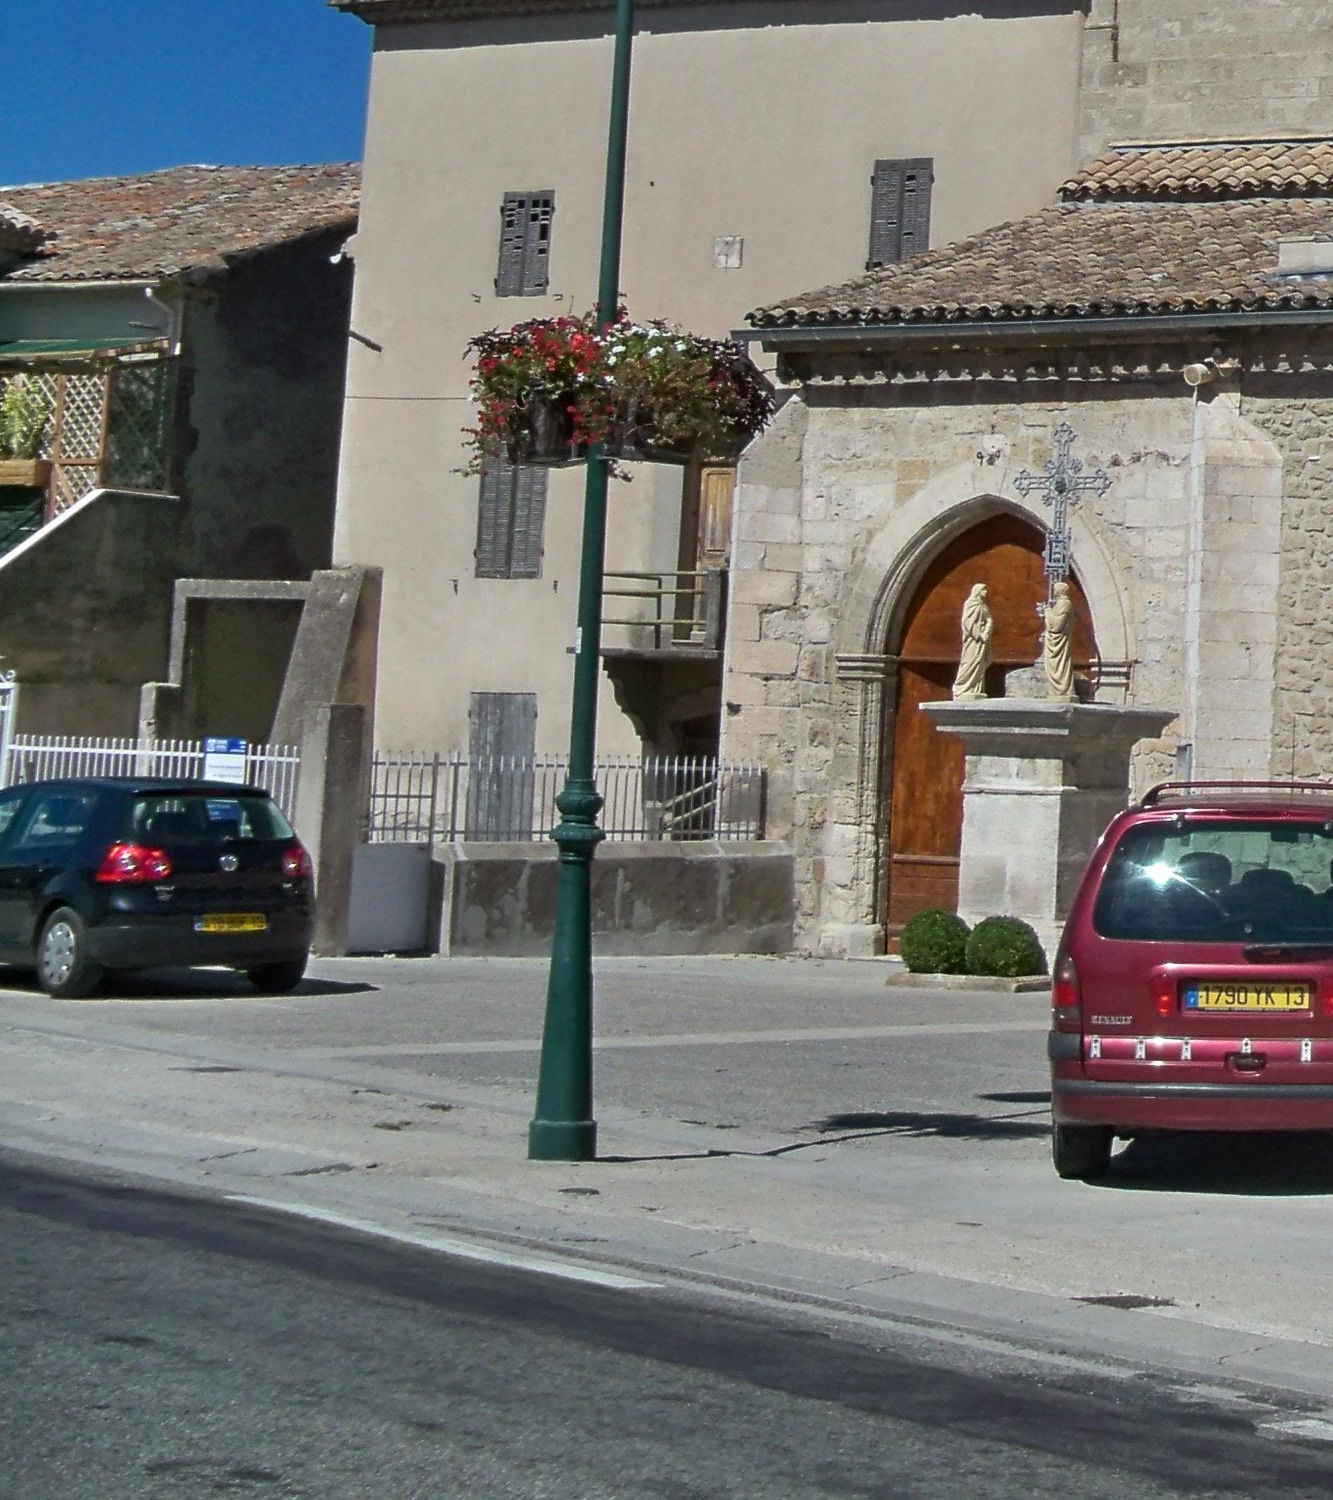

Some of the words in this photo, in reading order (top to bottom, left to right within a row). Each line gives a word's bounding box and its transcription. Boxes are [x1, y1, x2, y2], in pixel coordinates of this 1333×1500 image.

[1202, 984, 1249, 1005] 1790
[1253, 985, 1276, 1005] YK
[1283, 986, 1305, 1006] 13
